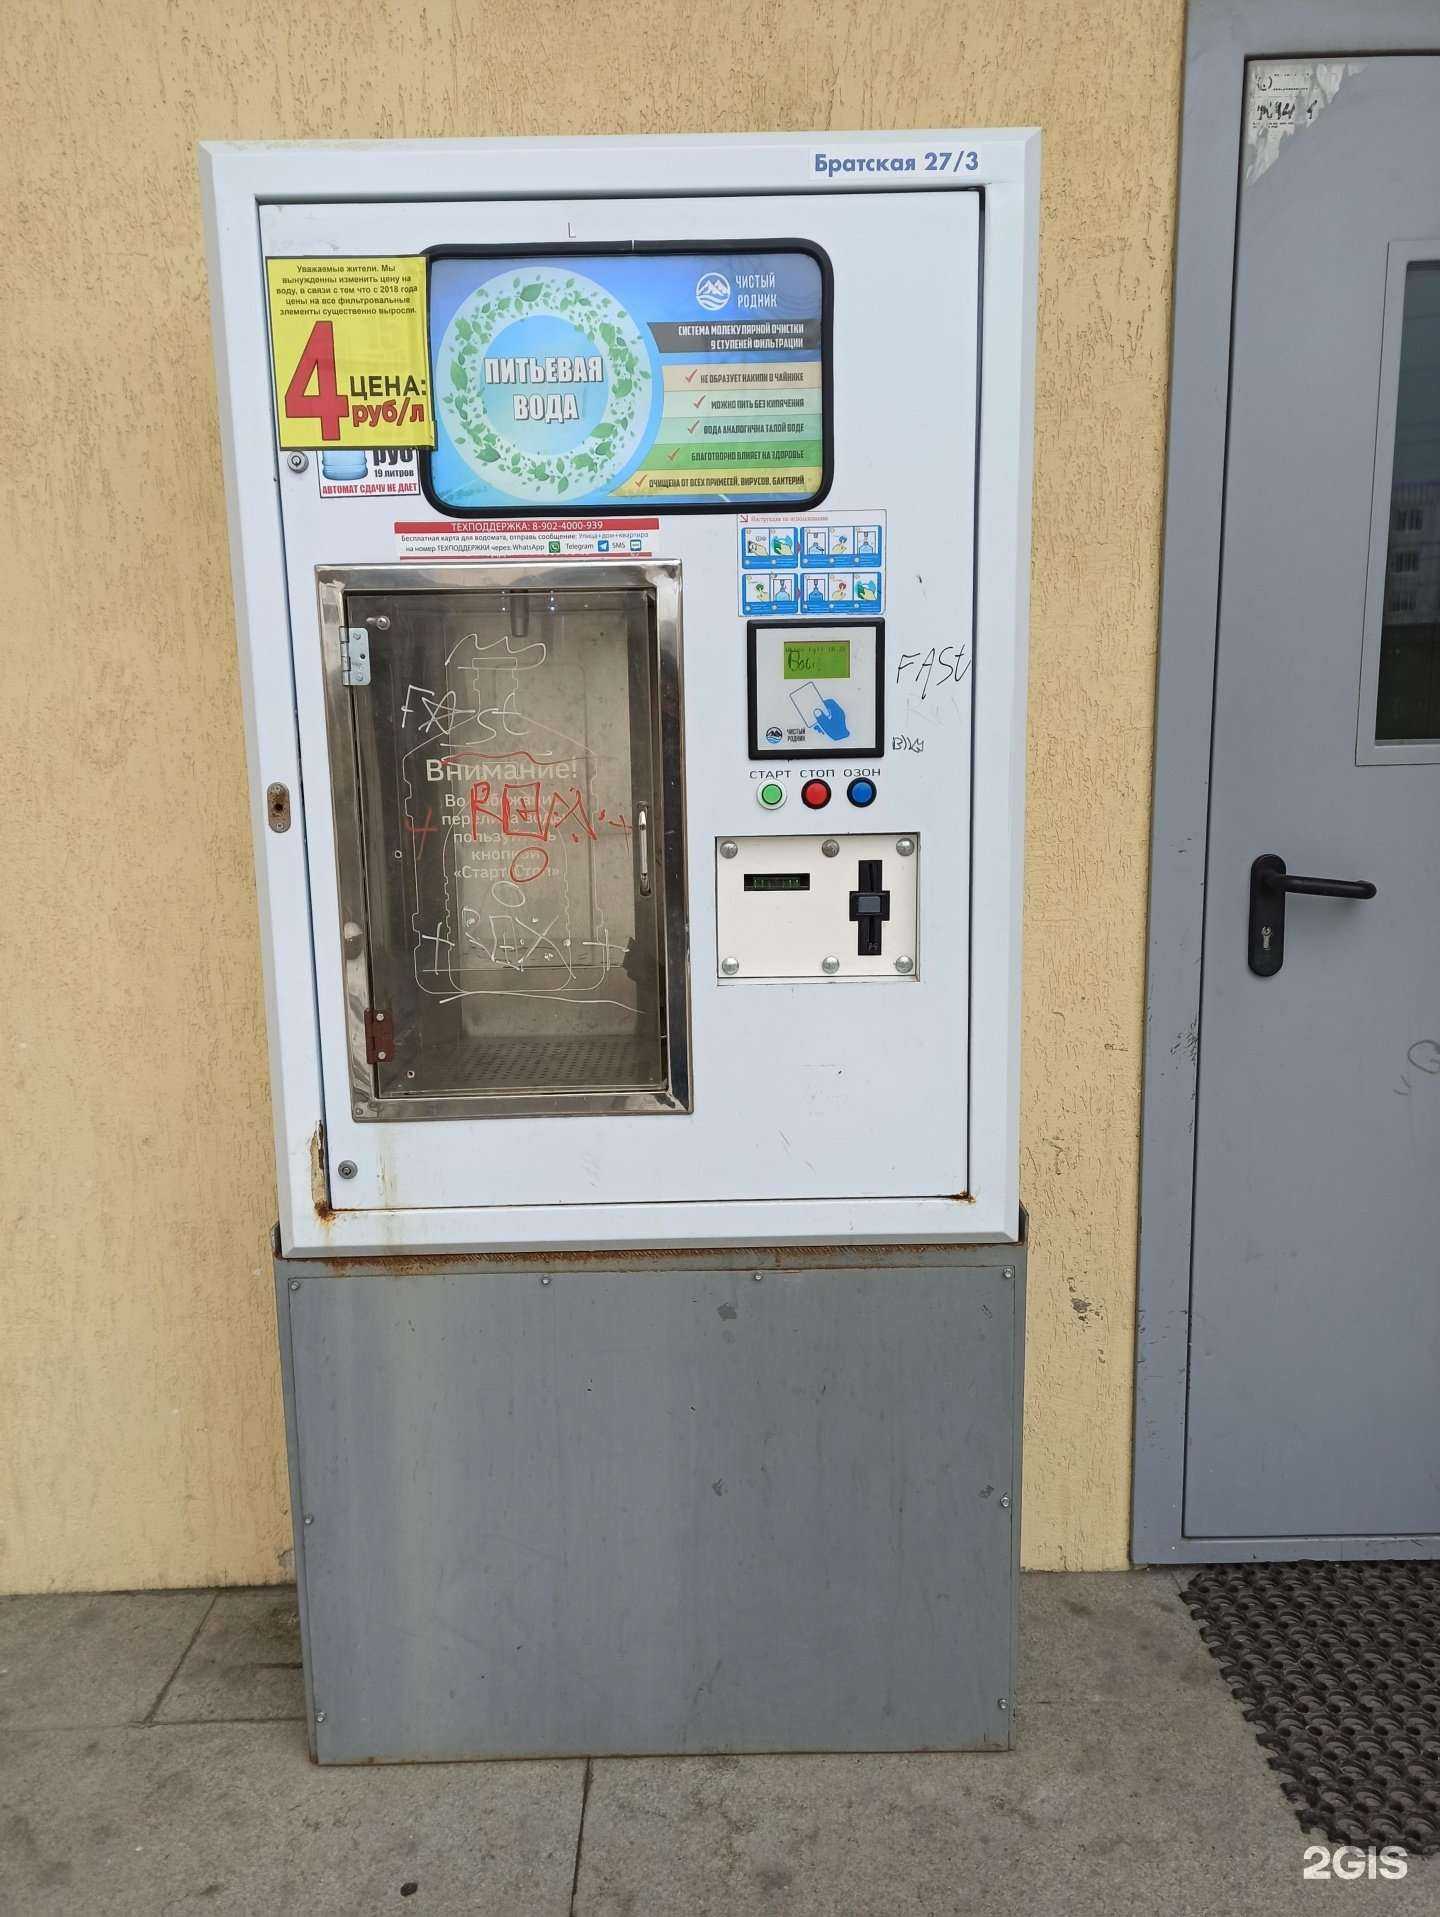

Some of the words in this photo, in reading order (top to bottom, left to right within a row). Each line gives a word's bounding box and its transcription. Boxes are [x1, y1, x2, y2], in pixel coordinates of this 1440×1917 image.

[815, 153, 916, 177] Братская
[924, 150, 979, 173] 27/3
[297, 265, 345, 274] Уважаемые
[346, 265, 379, 273] жители.
[381, 264, 396, 272] Мы
[339, 276, 378, 284] изменить
[380, 275, 400, 284] цену
[735, 272, 776, 289] ЧИСТЫЙ
[276, 287, 298, 295] воду,
[357, 286, 371, 294] что
[379, 285, 399, 294] 2018
[401, 285, 418, 293] года
[286, 298, 308, 306] цены
[322, 297, 336, 305] все
[338, 296, 410, 306] фильтровальные
[737, 293, 778, 310] РОДНИК
[280, 308, 321, 316] элементы
[322, 307, 377, 317] существенно
[379, 306, 417, 316] выросли.
[678, 325, 710, 336] СИСТЕМА
[711, 322, 771, 335] МОЛЕКУЛЯРНОЙ
[771, 322, 804, 334] ОЧИСТКИ
[710, 341, 716, 350] 9
[717, 337, 752, 350] СТУПЕНЕЙ
[753, 337, 804, 349] ФИЛЬТРАЦИИ
[484, 356, 604, 385] ПИТЬЕВАЯ
[285, 321, 349, 440] 4
[700, 374, 708, 384] НЕ
[709, 373, 742, 384] ОБРАЗУЕТ
[742, 373, 768, 383] НАКИПИ
[769, 373, 774, 382] В
[775, 371, 804, 382] ЧАЙНИКЕ
[350, 374, 427, 401] ЦЕНА:
[513, 393, 579, 424] ВОДА
[711, 400, 736, 409] МОЖНО
[737, 399, 754, 409] ПИТЬ
[754, 399, 766, 408] БЕЗ
[766, 398, 804, 408] КИПЯЧЕНИЯ
[352, 397, 425, 427] руб/л
[703, 425, 722, 435] ВОДА
[723, 424, 765, 435] АНАЛОГИЧНА
[765, 422, 787, 434] ТАЛОЙ
[787, 423, 804, 433] ВОДЕ
[691, 452, 737, 461] БЛАГОТВОРНО
[737, 451, 762, 461] ВЛИЯЕТ
[762, 450, 771, 460] НА
[771, 450, 804, 460] ЗДОРОВЬЕ
[374, 469, 383, 478] 19
[385, 469, 415, 478] литров
[649, 478, 681, 488] ОЧИЩЕНА
[681, 478, 690, 488] ОТ
[690, 478, 705, 487] ВСЕХ
[772, 474, 804, 486] БАКТЕРИЙ
[322, 484, 359, 494] АВТОМАТ
[360, 483, 386, 494] СДАЧУ
[387, 483, 397, 492] НЕ
[398, 482, 417, 493] ДАЕТ
[452, 521, 530, 533] ТЕХПОДДЕРЖКА:
[532, 520, 604, 532] 8-902-4000-939
[401, 534, 440, 542] Бесплатная
[440, 534, 460, 542] карта
[461, 534, 474, 542] для
[475, 534, 508, 542] водомата,
[509, 534, 537, 542] отправь
[538, 532, 577, 541] сообщение:
[415, 545, 436, 553] номер
[437, 543, 490, 553] ТЕХПОДДЕРЖКИ
[513, 543, 545, 552] WhatsApp
[566, 541, 594, 551] Telegram
[611, 541, 626, 549] SMS
[426, 756, 577, 782] Внимание!
[749, 769, 792, 779] СТАРТ
[799, 768, 835, 778] СТОП
[843, 767, 881, 777] ОЗОН
[445, 794, 466, 808] Во
[442, 814, 518, 828] перелиа
